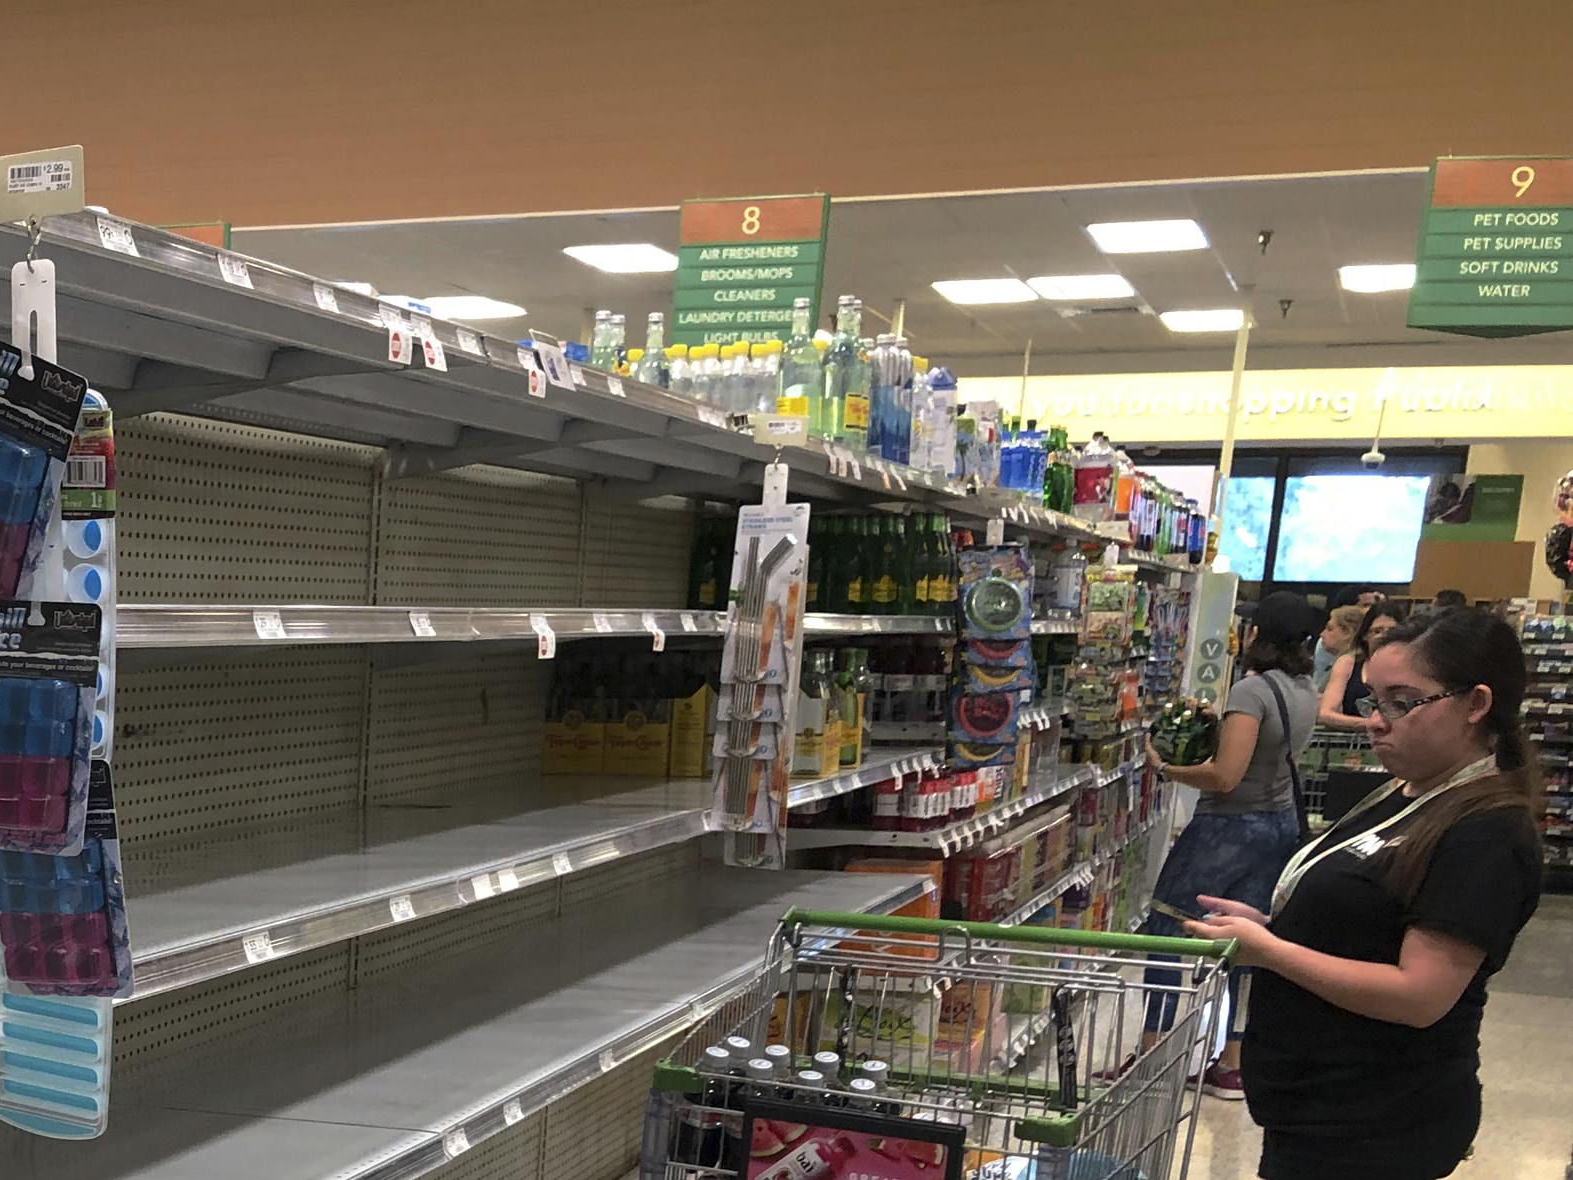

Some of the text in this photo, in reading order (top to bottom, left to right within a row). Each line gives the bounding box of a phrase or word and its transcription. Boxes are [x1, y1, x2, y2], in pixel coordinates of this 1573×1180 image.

[1512, 166, 1535, 198] 9
[742, 206, 760, 235] 8
[1474, 213, 1559, 226] PET FOODS
[1463, 237, 1562, 250] PET SUPPLIES
[699, 246, 799, 260] AIR FRESHENERS
[1460, 261, 1559, 274] SOFT DRINKS
[701, 267, 794, 282] BROOMS/MOPS
[714, 289, 776, 302] CLEANERS
[1478, 285, 1531, 298] WATER
[679, 310, 794, 324] LAUNDRY DETERGE
[704, 331, 778, 344] LIGHT BULBS
[796, 1151, 817, 1173] bai
